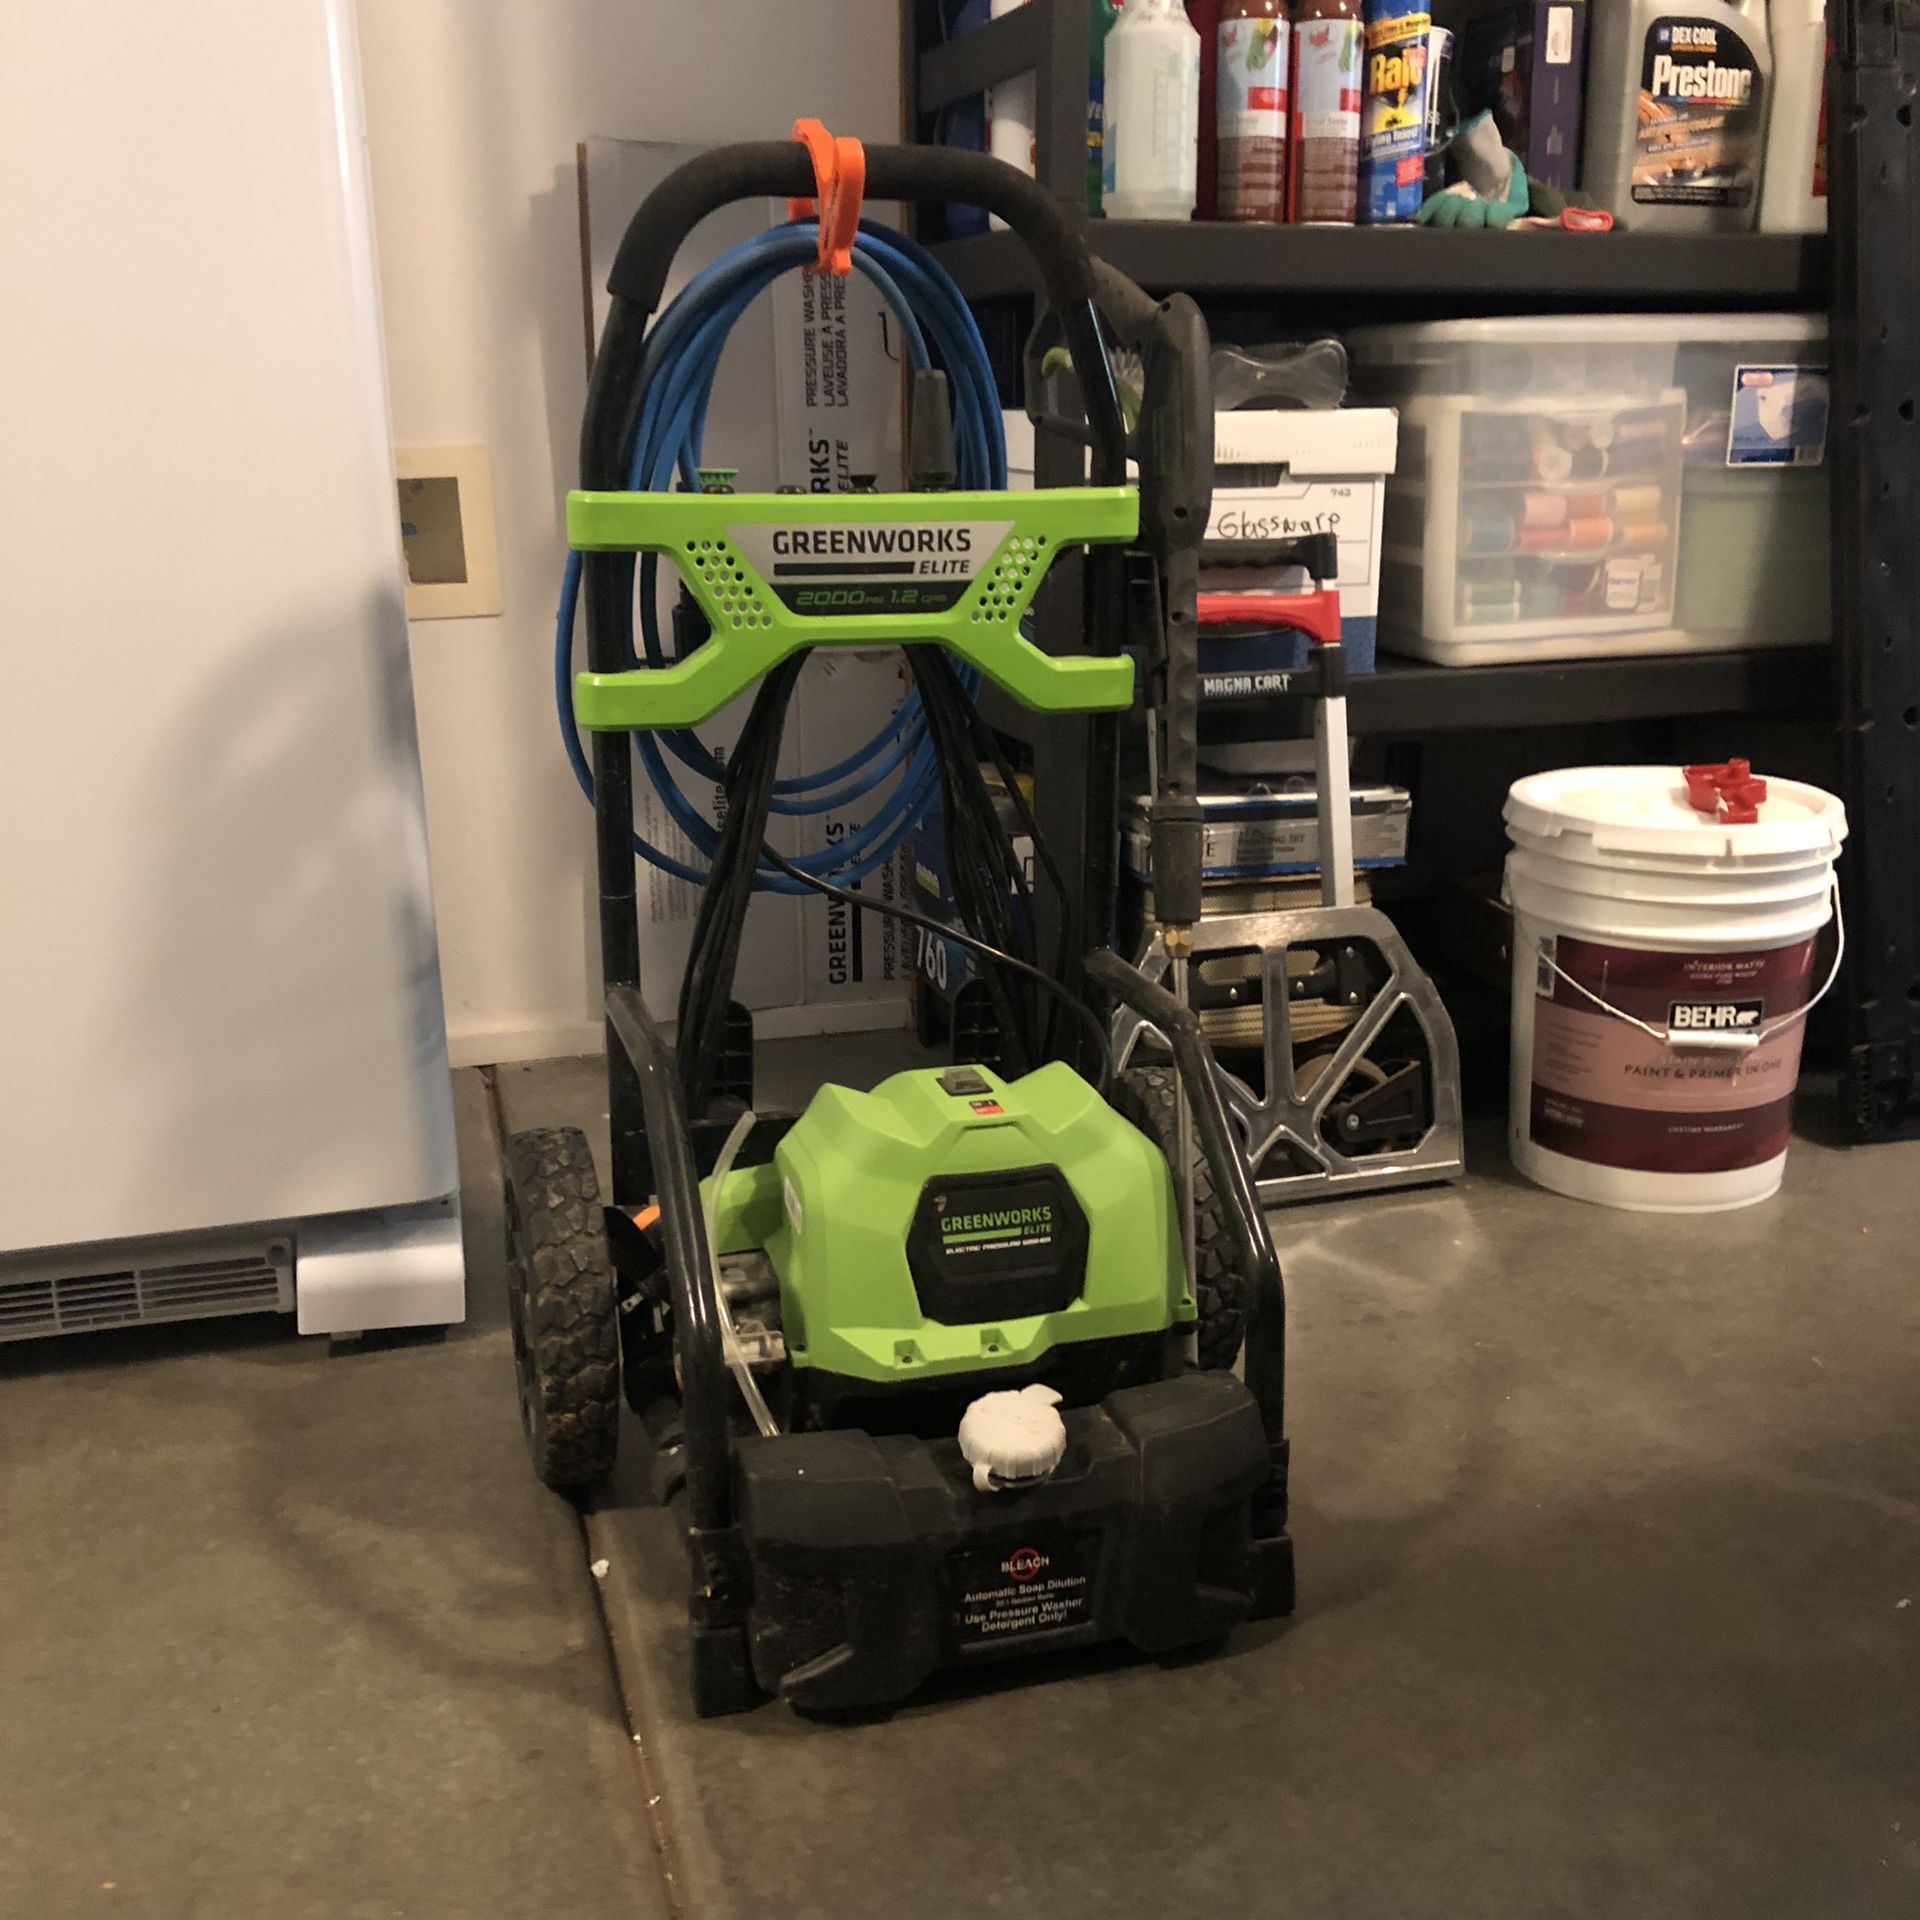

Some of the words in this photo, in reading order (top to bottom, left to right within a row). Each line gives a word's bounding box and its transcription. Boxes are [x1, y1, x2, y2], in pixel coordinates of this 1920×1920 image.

[1369, 45, 1426, 95] Raid
[1652, 54, 1752, 99] Prestone
[802, 271, 815, 323] WASHE
[820, 272, 832, 322] PRESS
[803, 327, 818, 407] PRESSURE
[821, 337, 836, 407] LAVEUSE
[835, 328, 849, 407] LAVADORA
[836, 440, 850, 492] ELITE
[772, 528, 971, 554] GREENWORKS
[919, 560, 970, 574] ELITE
[796, 590, 865, 605] 2000
[891, 589, 918, 604] 1.2
[1204, 676, 1252, 696] MAGNA
[1254, 673, 1289, 693] CART
[826, 822, 848, 985] GREENS
[1674, 1005, 1735, 1028] BEHR
[1624, 1064, 1668, 1077] PAINT
[1674, 1069, 1685, 1079] &
[1689, 1066, 1742, 1079] PRIMER
[1746, 1064, 1759, 1075] IN
[1761, 1059, 1782, 1073] ONE
[941, 1206, 1051, 1232] GREENWORKS
[1024, 1223, 1051, 1235] ELITE
[1001, 1556, 1049, 1573] BLEACH
[964, 1587, 1017, 1603] Automatic
[1019, 1582, 1045, 1596] Soap
[1047, 1575, 1086, 1588] Dilution
[965, 1613, 986, 1625] Use
[989, 1605, 1038, 1621] Pressure
[1041, 1598, 1083, 1612] Washer
[981, 1617, 1035, 1633] Detergent
[1038, 1610, 1067, 1624] Only!
